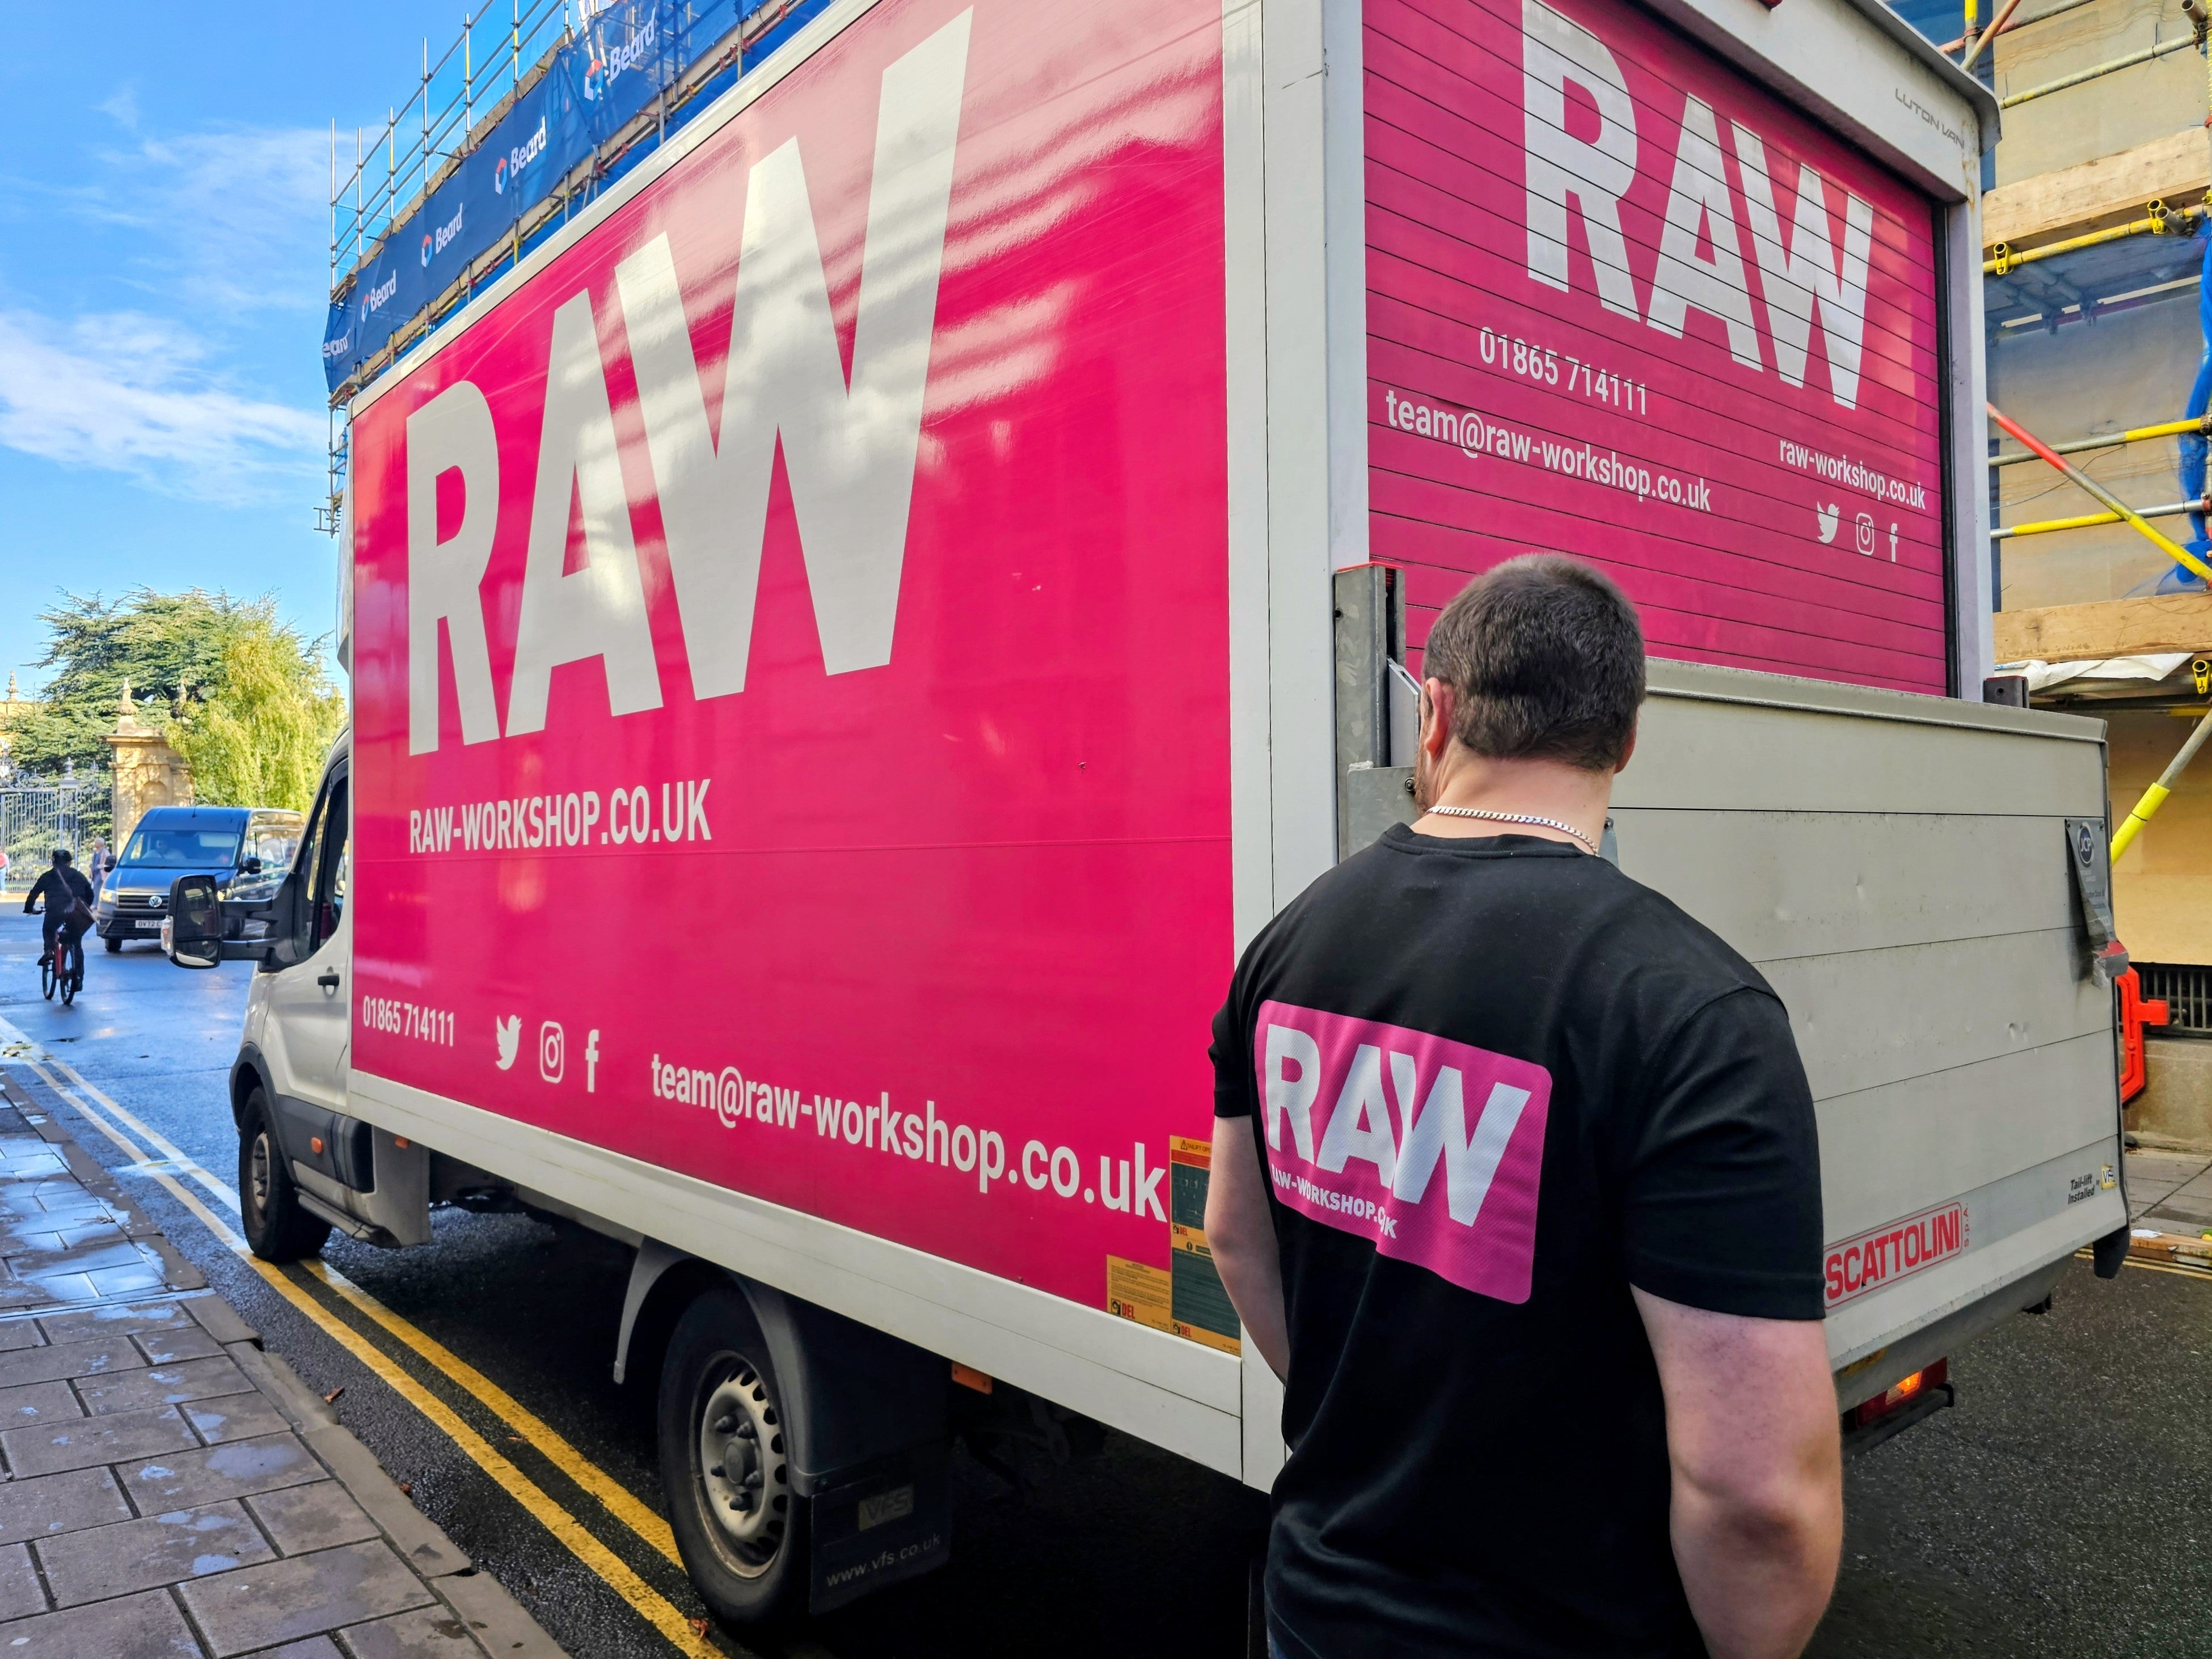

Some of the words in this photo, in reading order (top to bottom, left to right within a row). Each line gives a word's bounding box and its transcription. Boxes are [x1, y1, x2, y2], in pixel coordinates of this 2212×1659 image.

[610, 7, 656, 82] Beard
[510, 115, 546, 178] Beard
[1895, 88, 1939, 130] LUTON
[1942, 124, 1964, 149] VAN
[436, 202, 463, 254] Beard
[1522, 0, 1874, 411] RAW
[370, 269, 396, 312] Beard
[322, 328, 351, 358] eard
[1480, 327, 1558, 385] 01865
[1565, 356, 1645, 415] 714111
[406, 5, 974, 757] RAW
[1386, 390, 1711, 512] team@raw-workshop.co.uk
[1780, 437, 1926, 510] raw-workshop.co.uk
[410, 779, 712, 854] RAW-WORKSHOP.CO.UK
[2080, 837, 2091, 852] JCP
[362, 995, 401, 1034] 01865
[404, 1003, 454, 1046] 714111
[651, 1054, 1167, 1223] team@raw-workshop.co.uk
[1265, 1023, 1532, 1228] RAW
[2068, 1184, 2095, 1205] Installed
[2071, 1173, 2092, 1191] Tail-lift
[1826, 1209, 1960, 1301] SCATTOLINI
[1122, 1302, 1135, 1319] DEL
[1181, 1325, 1191, 1337] DEL
